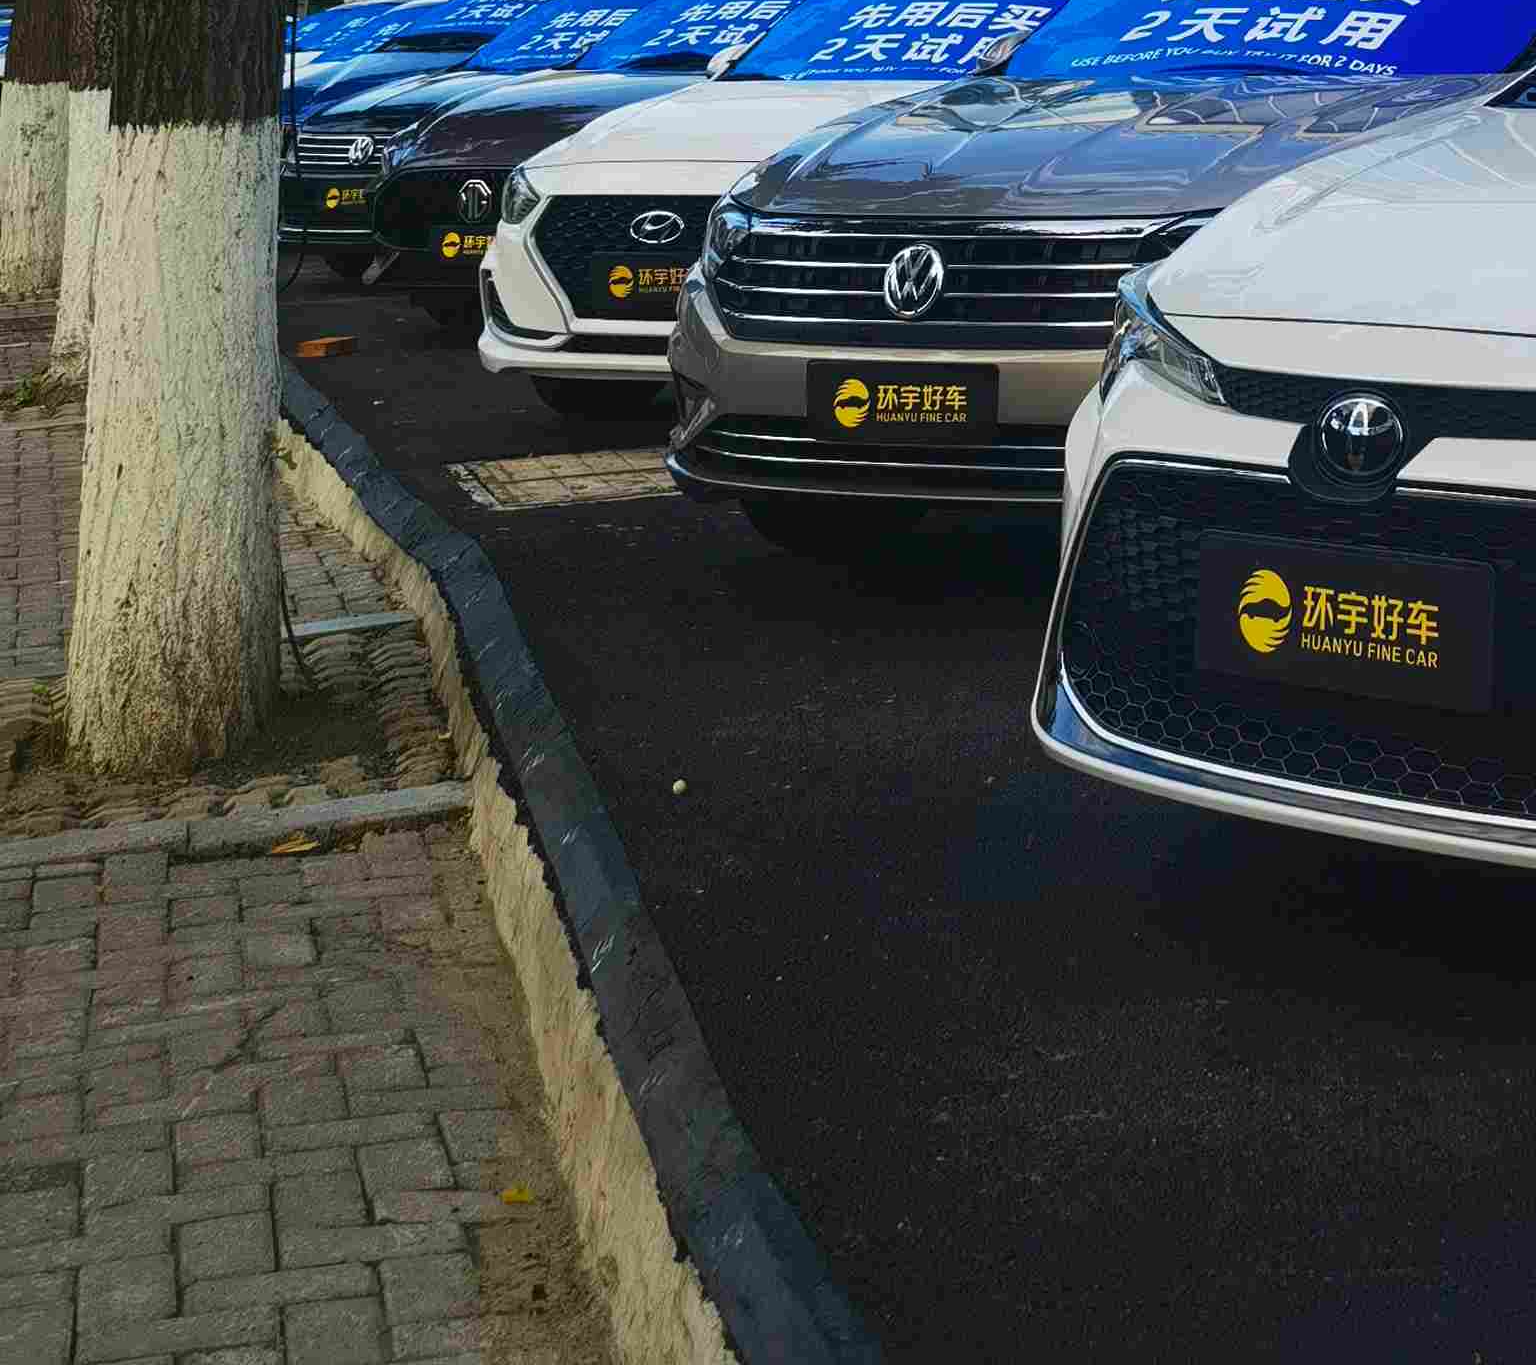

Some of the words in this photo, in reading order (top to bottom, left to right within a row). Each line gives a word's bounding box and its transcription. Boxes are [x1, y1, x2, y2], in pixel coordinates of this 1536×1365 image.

[839, 1, 1053, 32] 先用后买
[1118, 6, 1408, 51] 2天试用
[1101, 48, 1163, 66] BEFORE
[1333, 55, 1346, 68] 2
[1349, 59, 1398, 77] DAYS
[876, 385, 968, 411] 环宇好车
[876, 412, 918, 422] HUANYU
[920, 412, 943, 422] FINE
[945, 412, 967, 422] CAR
[1302, 585, 1440, 645] 环宇好车
[1301, 632, 1363, 657] HUANYU
[1367, 643, 1401, 663] FINE
[1405, 648, 1439, 669] CAR
